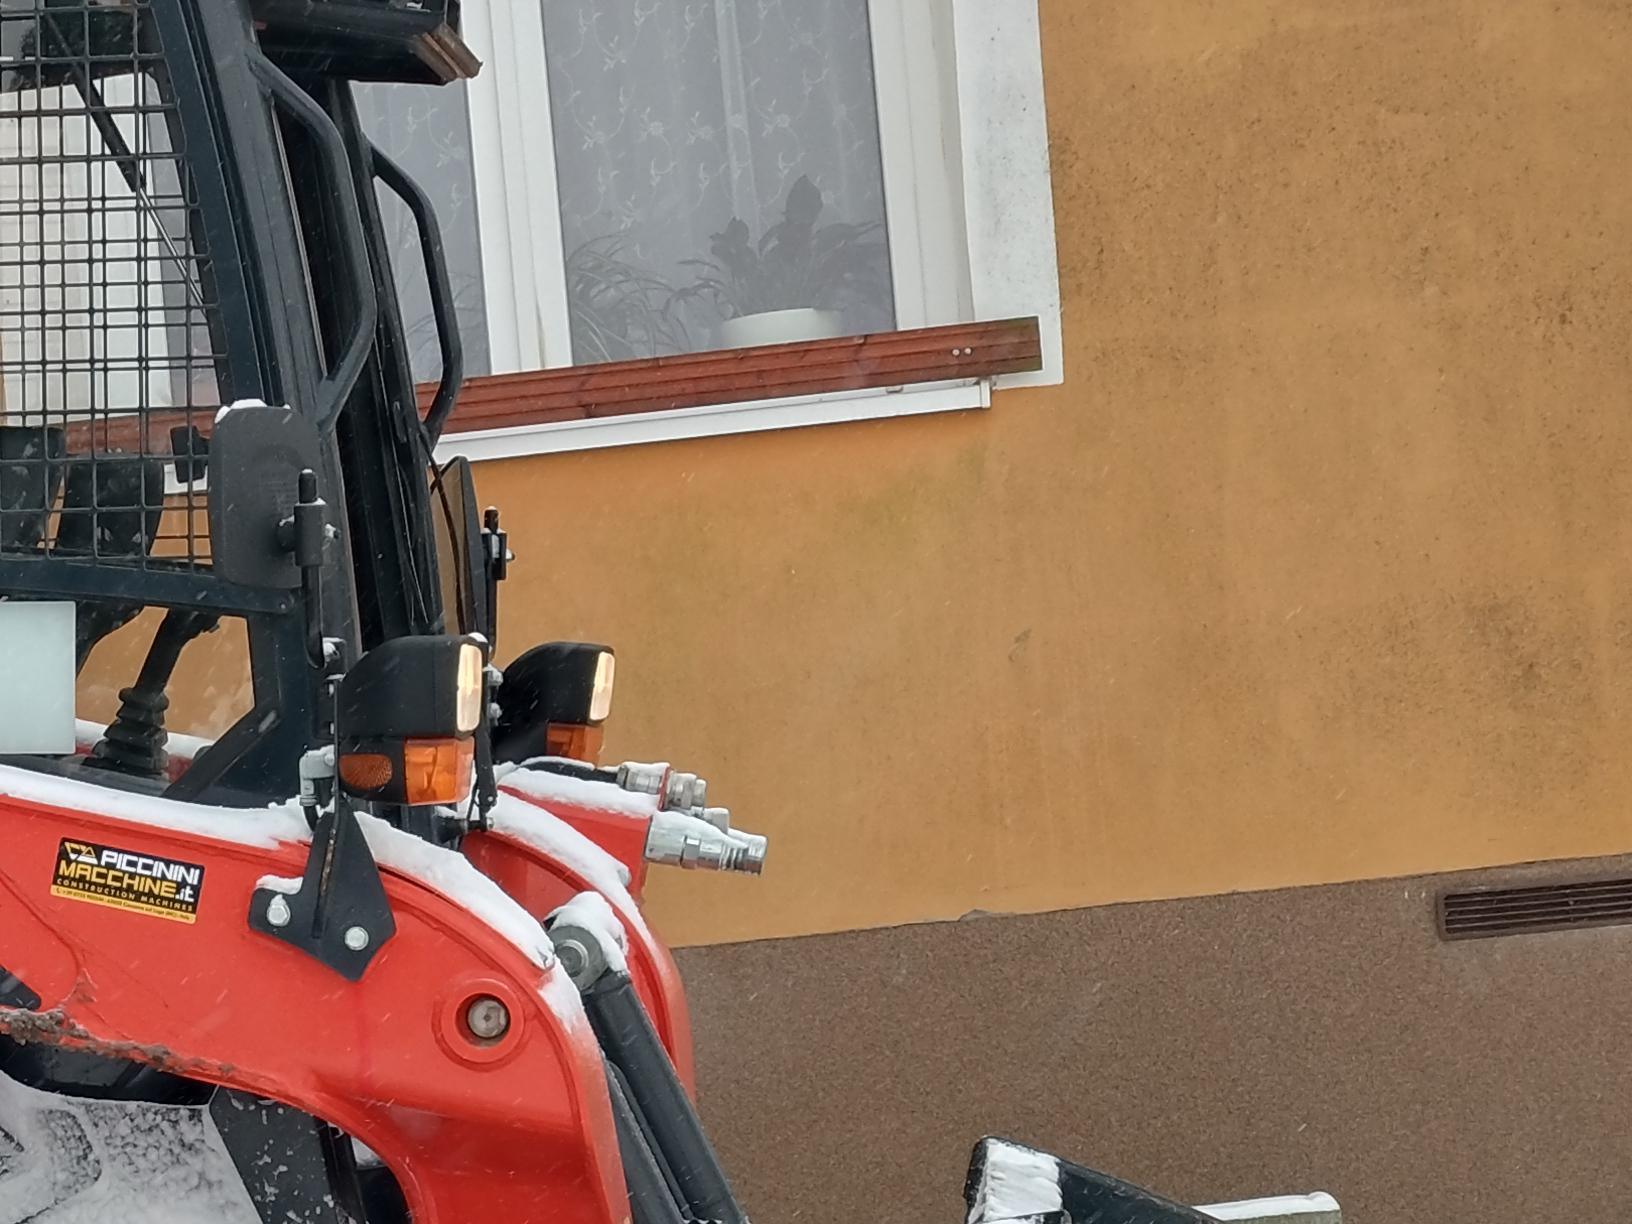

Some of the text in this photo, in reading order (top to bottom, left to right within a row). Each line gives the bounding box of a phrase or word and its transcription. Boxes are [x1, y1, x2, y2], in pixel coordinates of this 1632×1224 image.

[58, 859, 195, 903] MACCHINE.it
[100, 849, 201, 886] PICCININI
[56, 878, 136, 901] CONSTRUCTION
[140, 894, 194, 912] MACHINES
